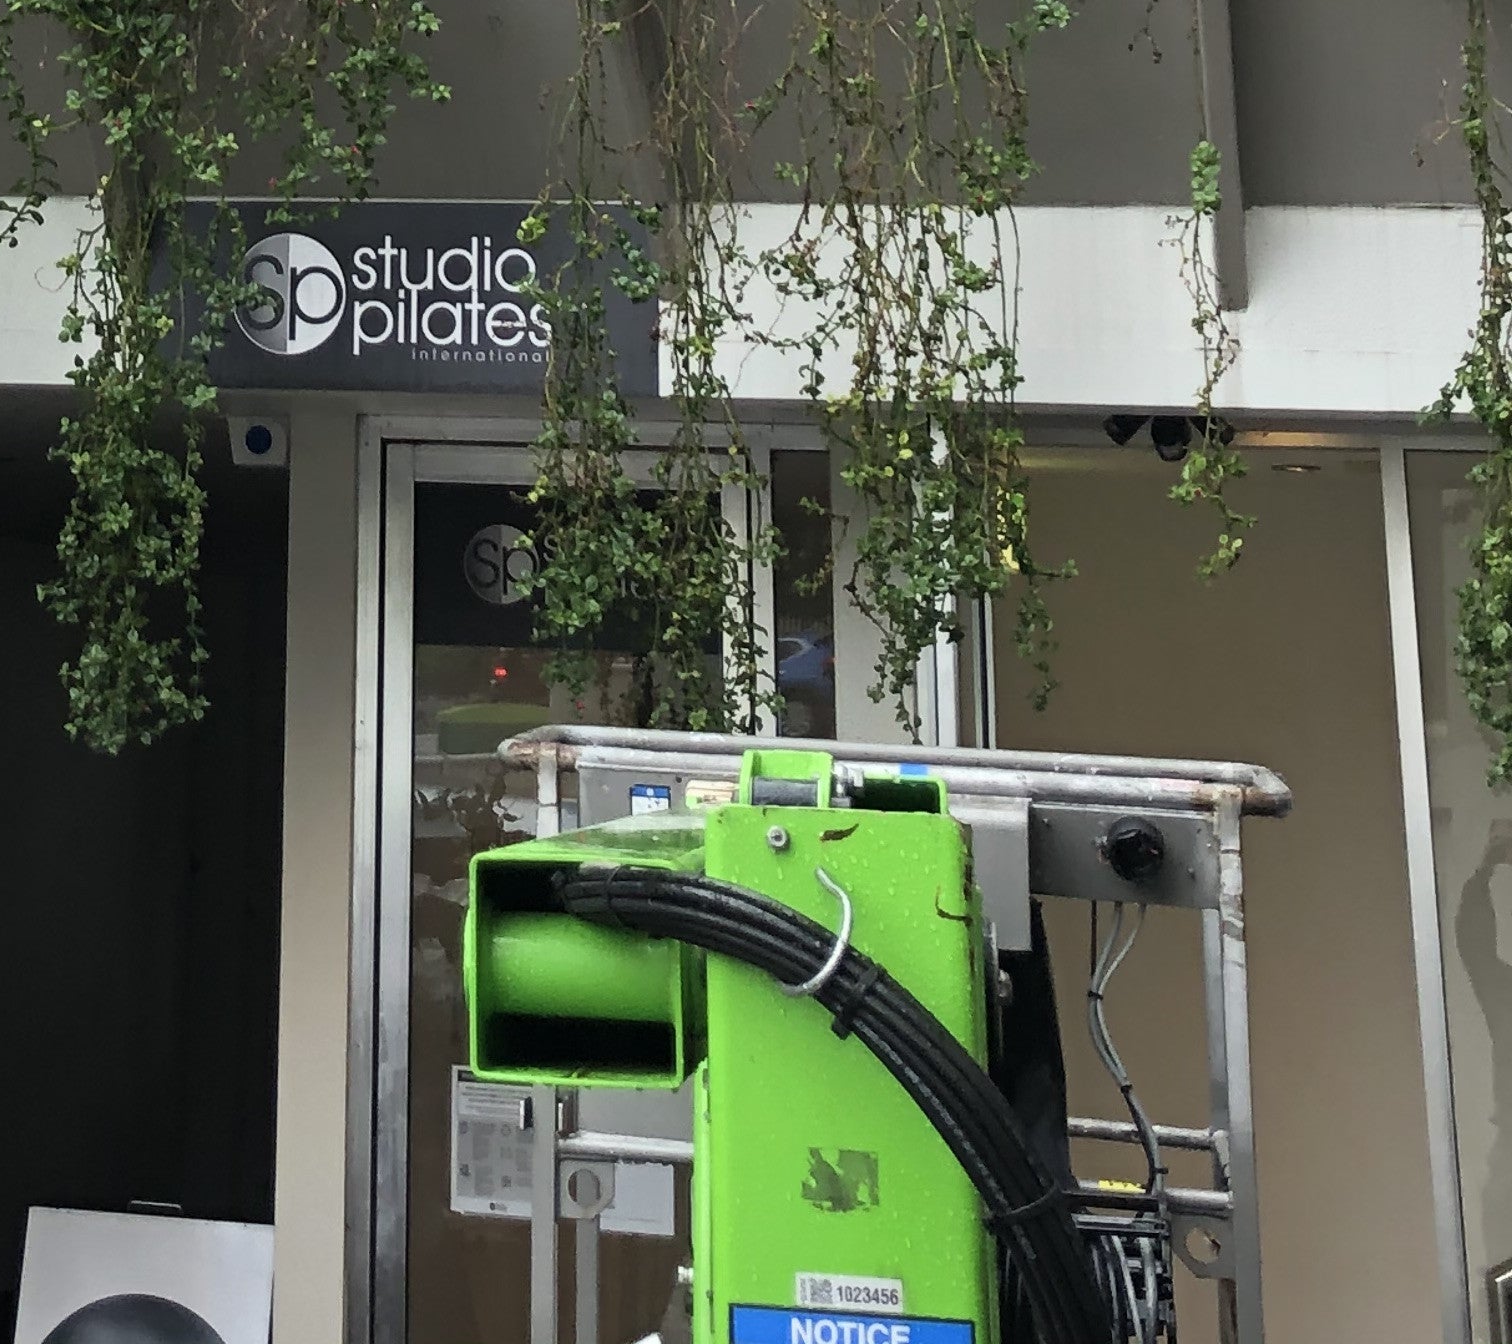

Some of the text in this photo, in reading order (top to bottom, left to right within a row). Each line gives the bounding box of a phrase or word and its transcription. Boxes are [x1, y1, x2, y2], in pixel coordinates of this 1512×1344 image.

[351, 235, 537, 293] studio
[353, 289, 553, 355] pilates
[412, 348, 550, 363] international
[837, 1284, 900, 1306] 1023456
[791, 1317, 911, 1344] NOTICE
